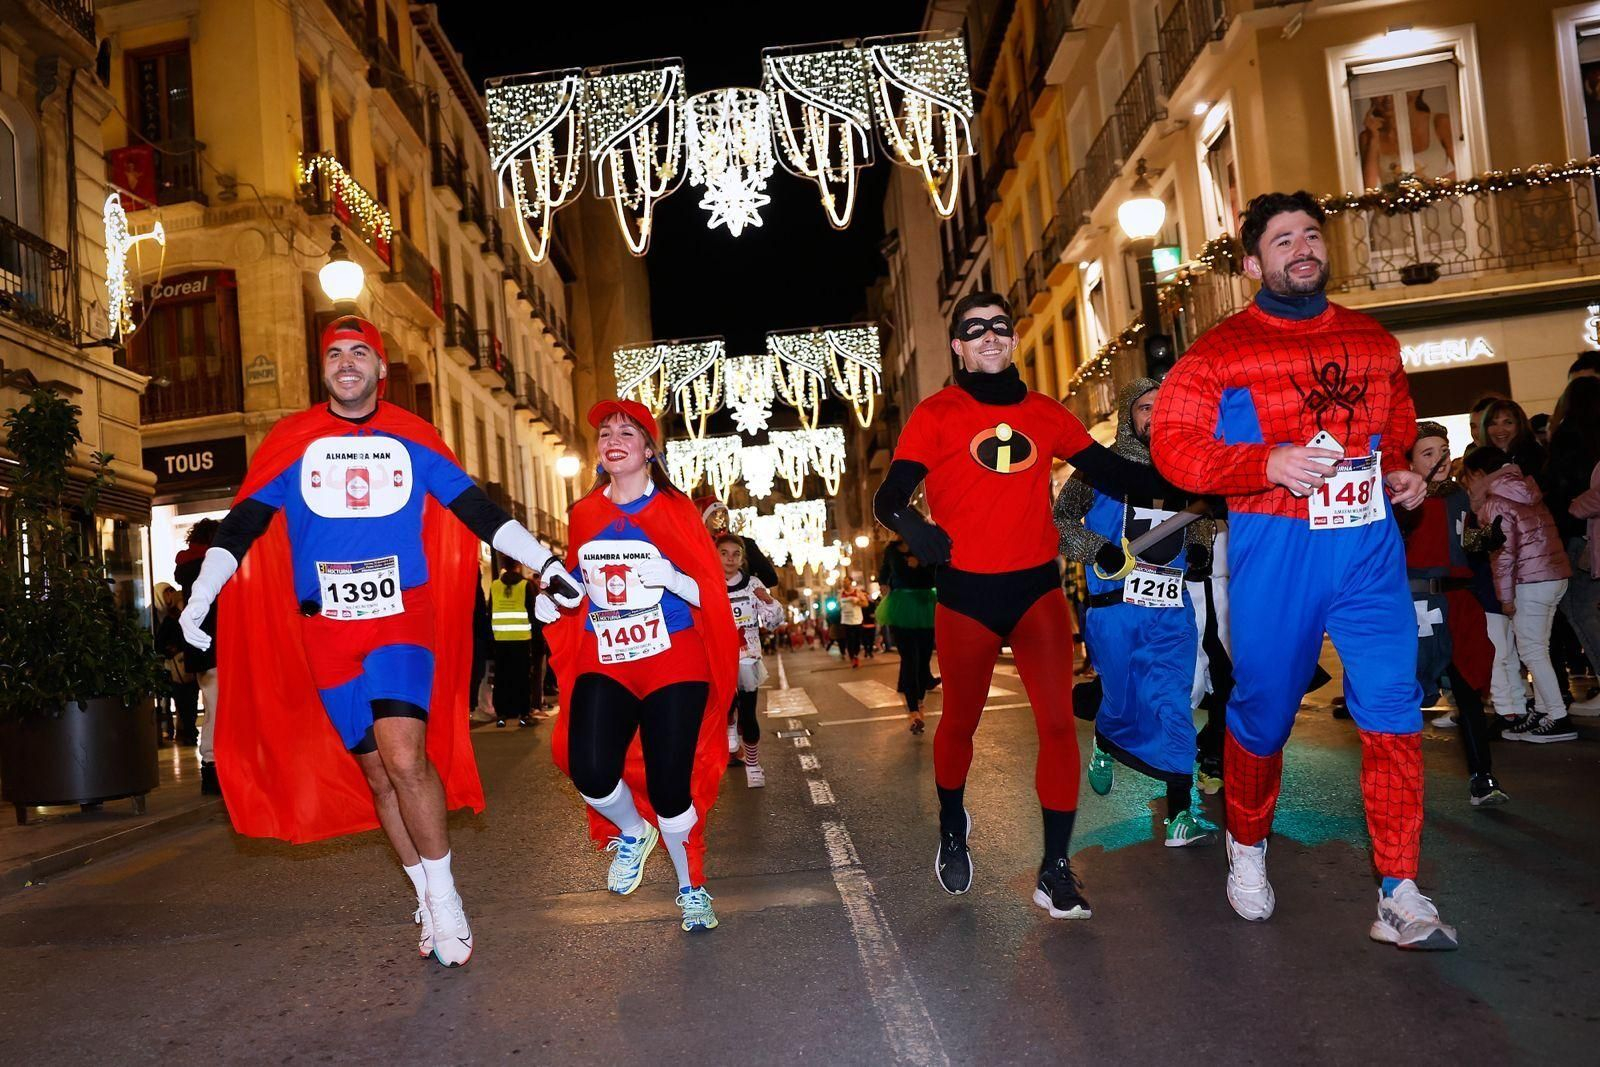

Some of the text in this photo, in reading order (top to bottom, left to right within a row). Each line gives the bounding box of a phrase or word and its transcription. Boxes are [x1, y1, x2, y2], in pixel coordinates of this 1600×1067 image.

[150, 276, 208, 299] Coreal
[164, 451, 213, 474] TOUS
[326, 452, 391, 461] ALHAMBRA MAN
[327, 578, 395, 603] 1390
[1130, 577, 1179, 599] 1218
[602, 618, 660, 647] 1407
